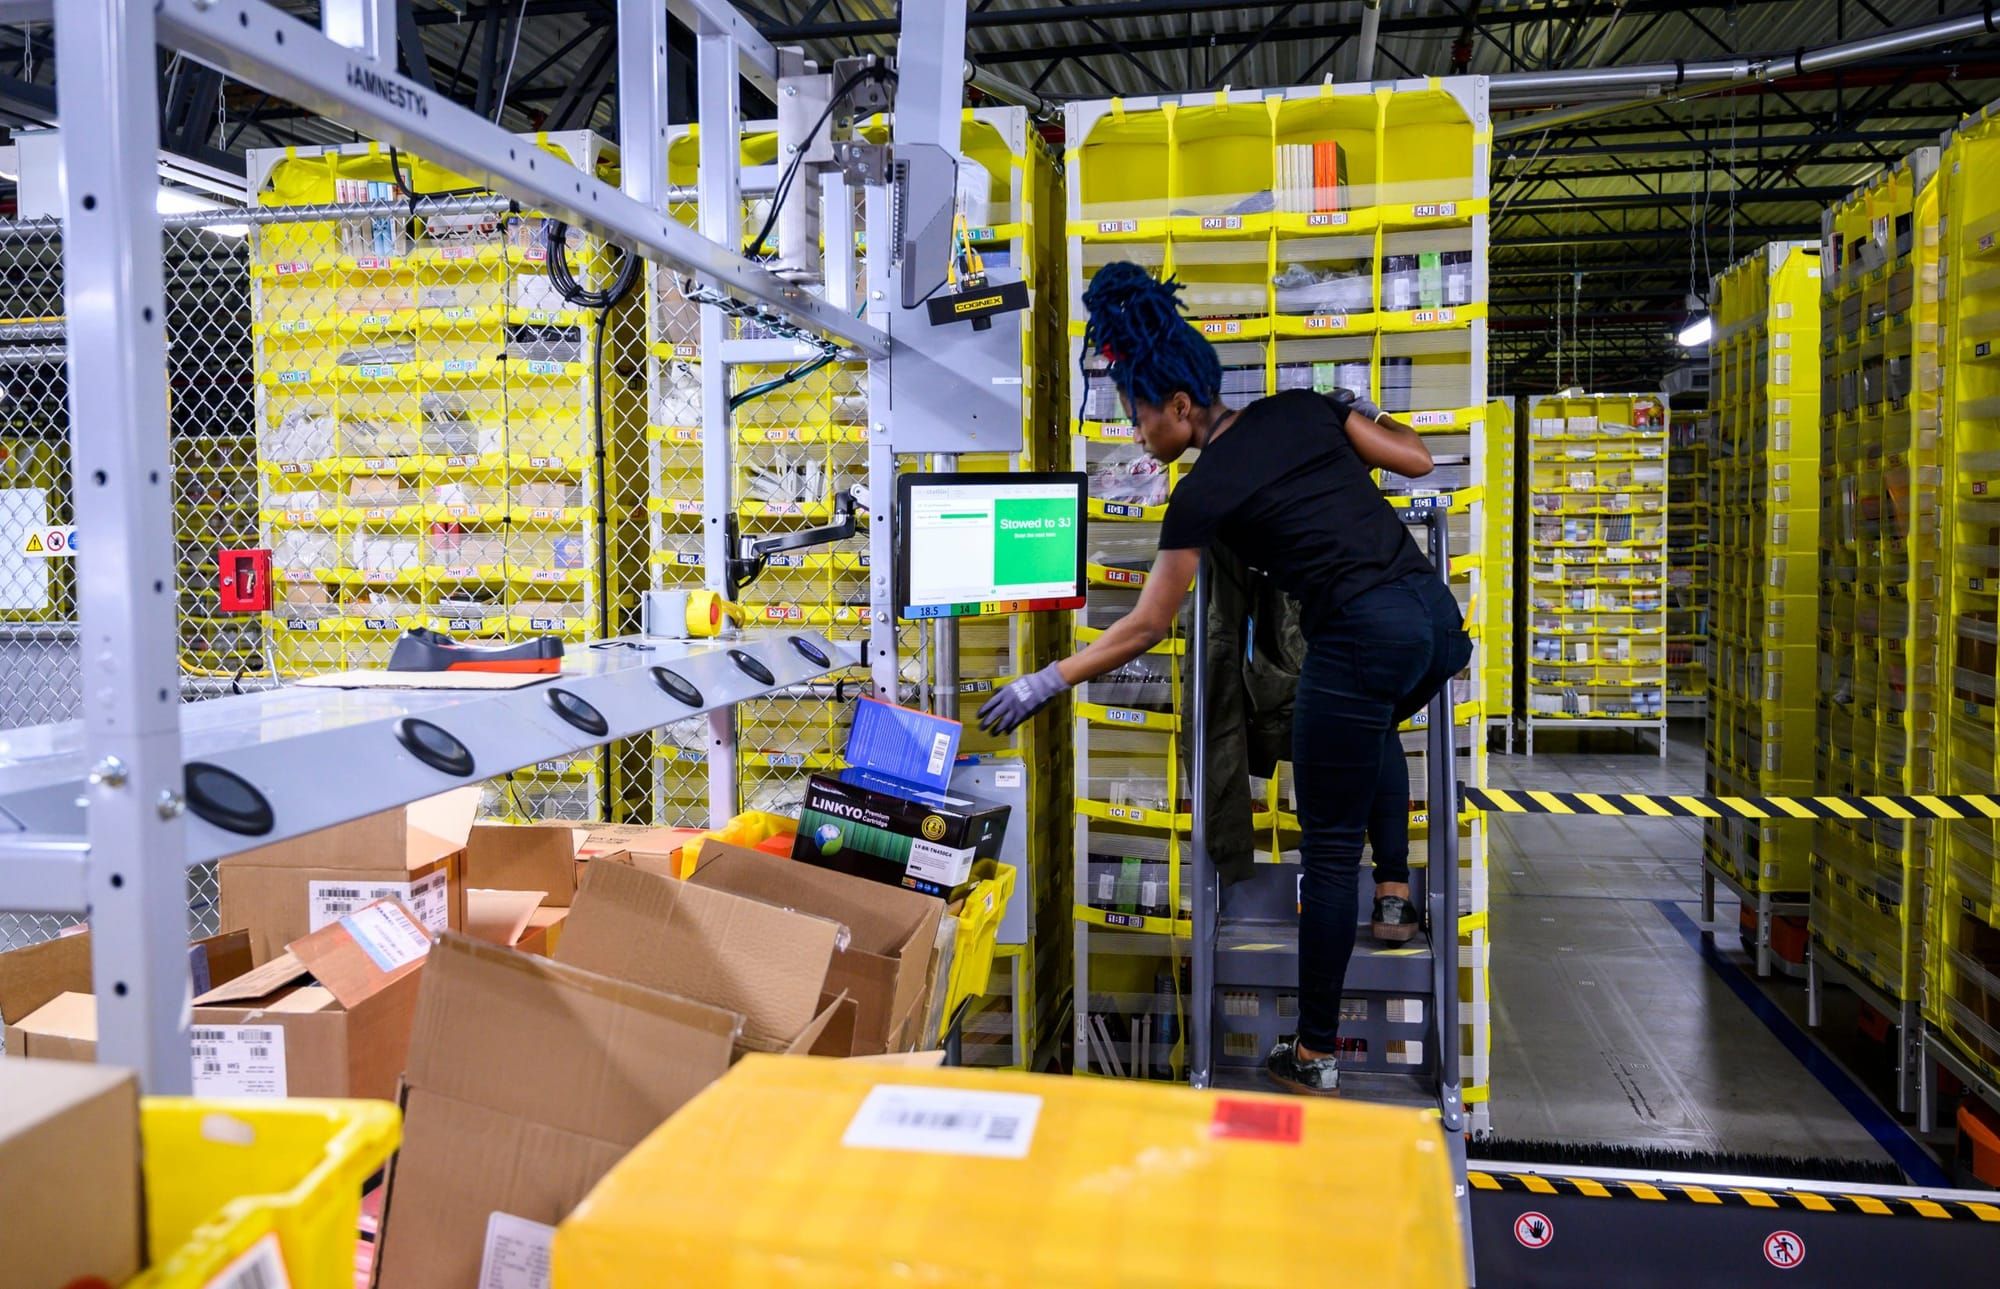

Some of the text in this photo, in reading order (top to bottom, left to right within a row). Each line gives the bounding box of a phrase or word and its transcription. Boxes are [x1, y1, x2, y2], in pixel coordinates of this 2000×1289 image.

[1417, 206, 1435, 216] 4J1
[1203, 218, 1221, 228] 2J1
[1311, 215, 1327, 225] 3J1
[1101, 223, 1118, 232] 1J1
[956, 297, 1002, 312] COGNEX
[1415, 312, 1432, 321] 4I1
[1309, 318, 1325, 328] 3I1
[1416, 415, 1432, 424] 4H1
[1106, 427, 1121, 436] 1H1
[1000, 517, 1072, 530] Stowed to 3J
[960, 605, 970, 614] 14
[985, 603, 995, 612] 11
[1011, 602, 1018, 611] 9
[920, 607, 939, 616] 18.5
[1111, 711, 1126, 720] 1D1
[811, 796, 890, 822] LINKYO Premium
[1109, 808, 1125, 817] 1C1
[862, 815, 889, 829] Cartridge
